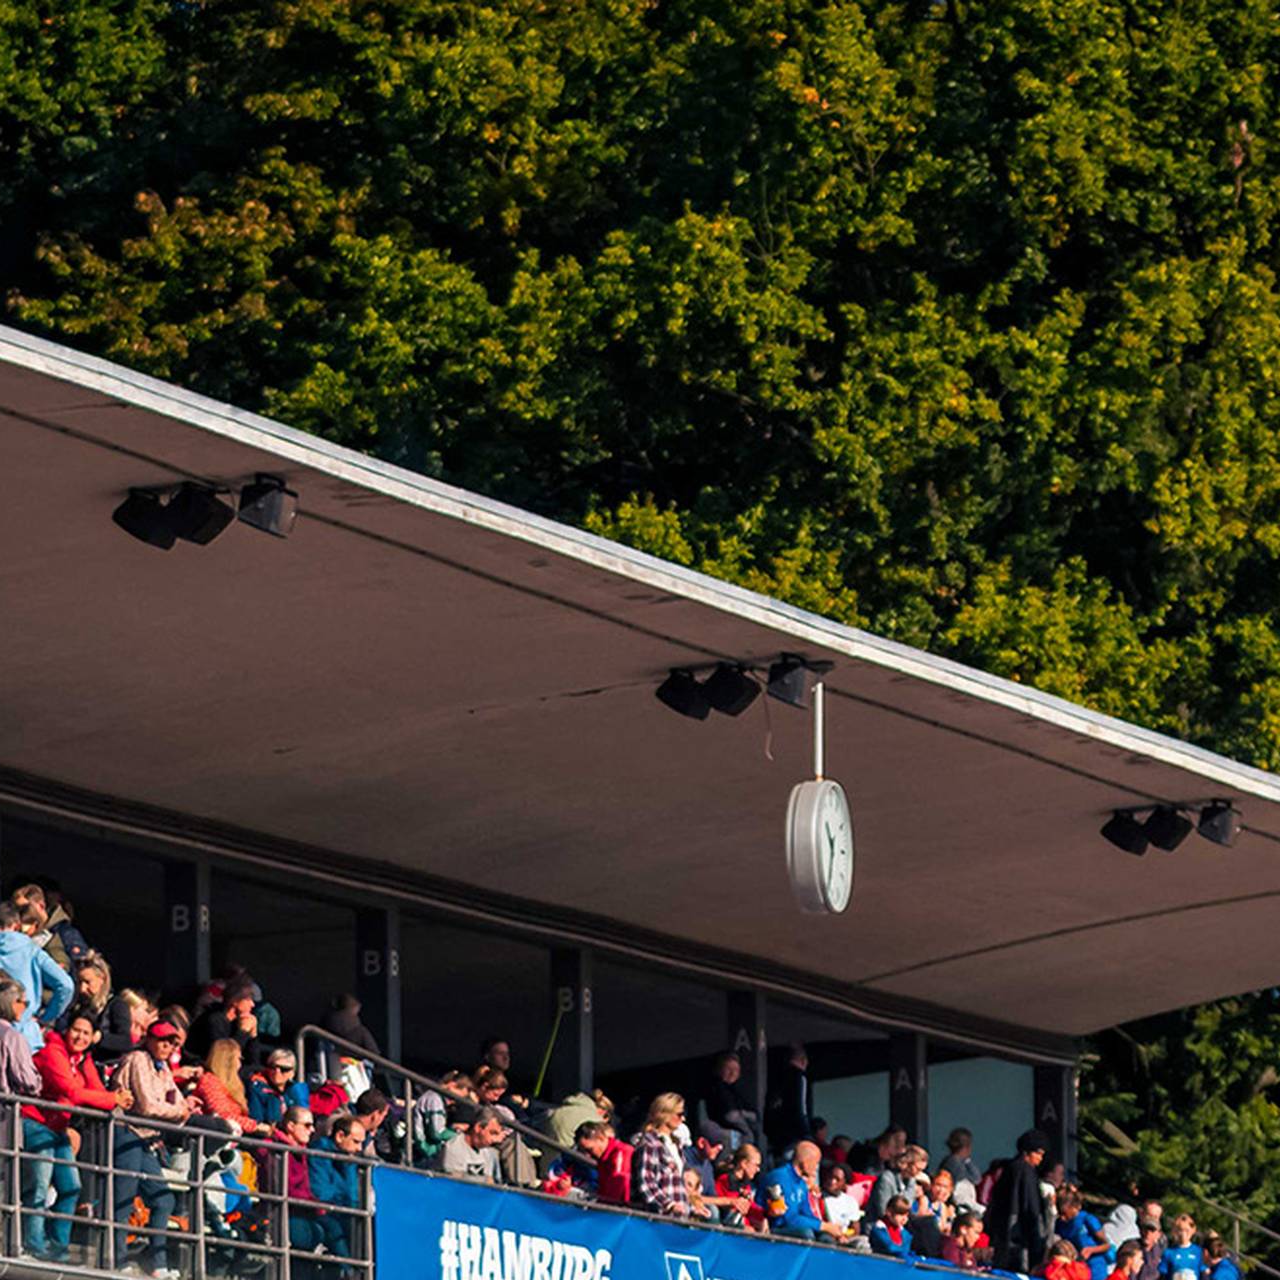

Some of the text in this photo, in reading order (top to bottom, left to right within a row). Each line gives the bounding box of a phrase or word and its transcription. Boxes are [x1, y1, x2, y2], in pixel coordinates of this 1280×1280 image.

[172, 905, 190, 931] B
[364, 949, 381, 976] B
[558, 986, 575, 1012] B
[734, 1028, 753, 1049] A
[895, 1068, 912, 1090] A
[1042, 1102, 1057, 1121] A
